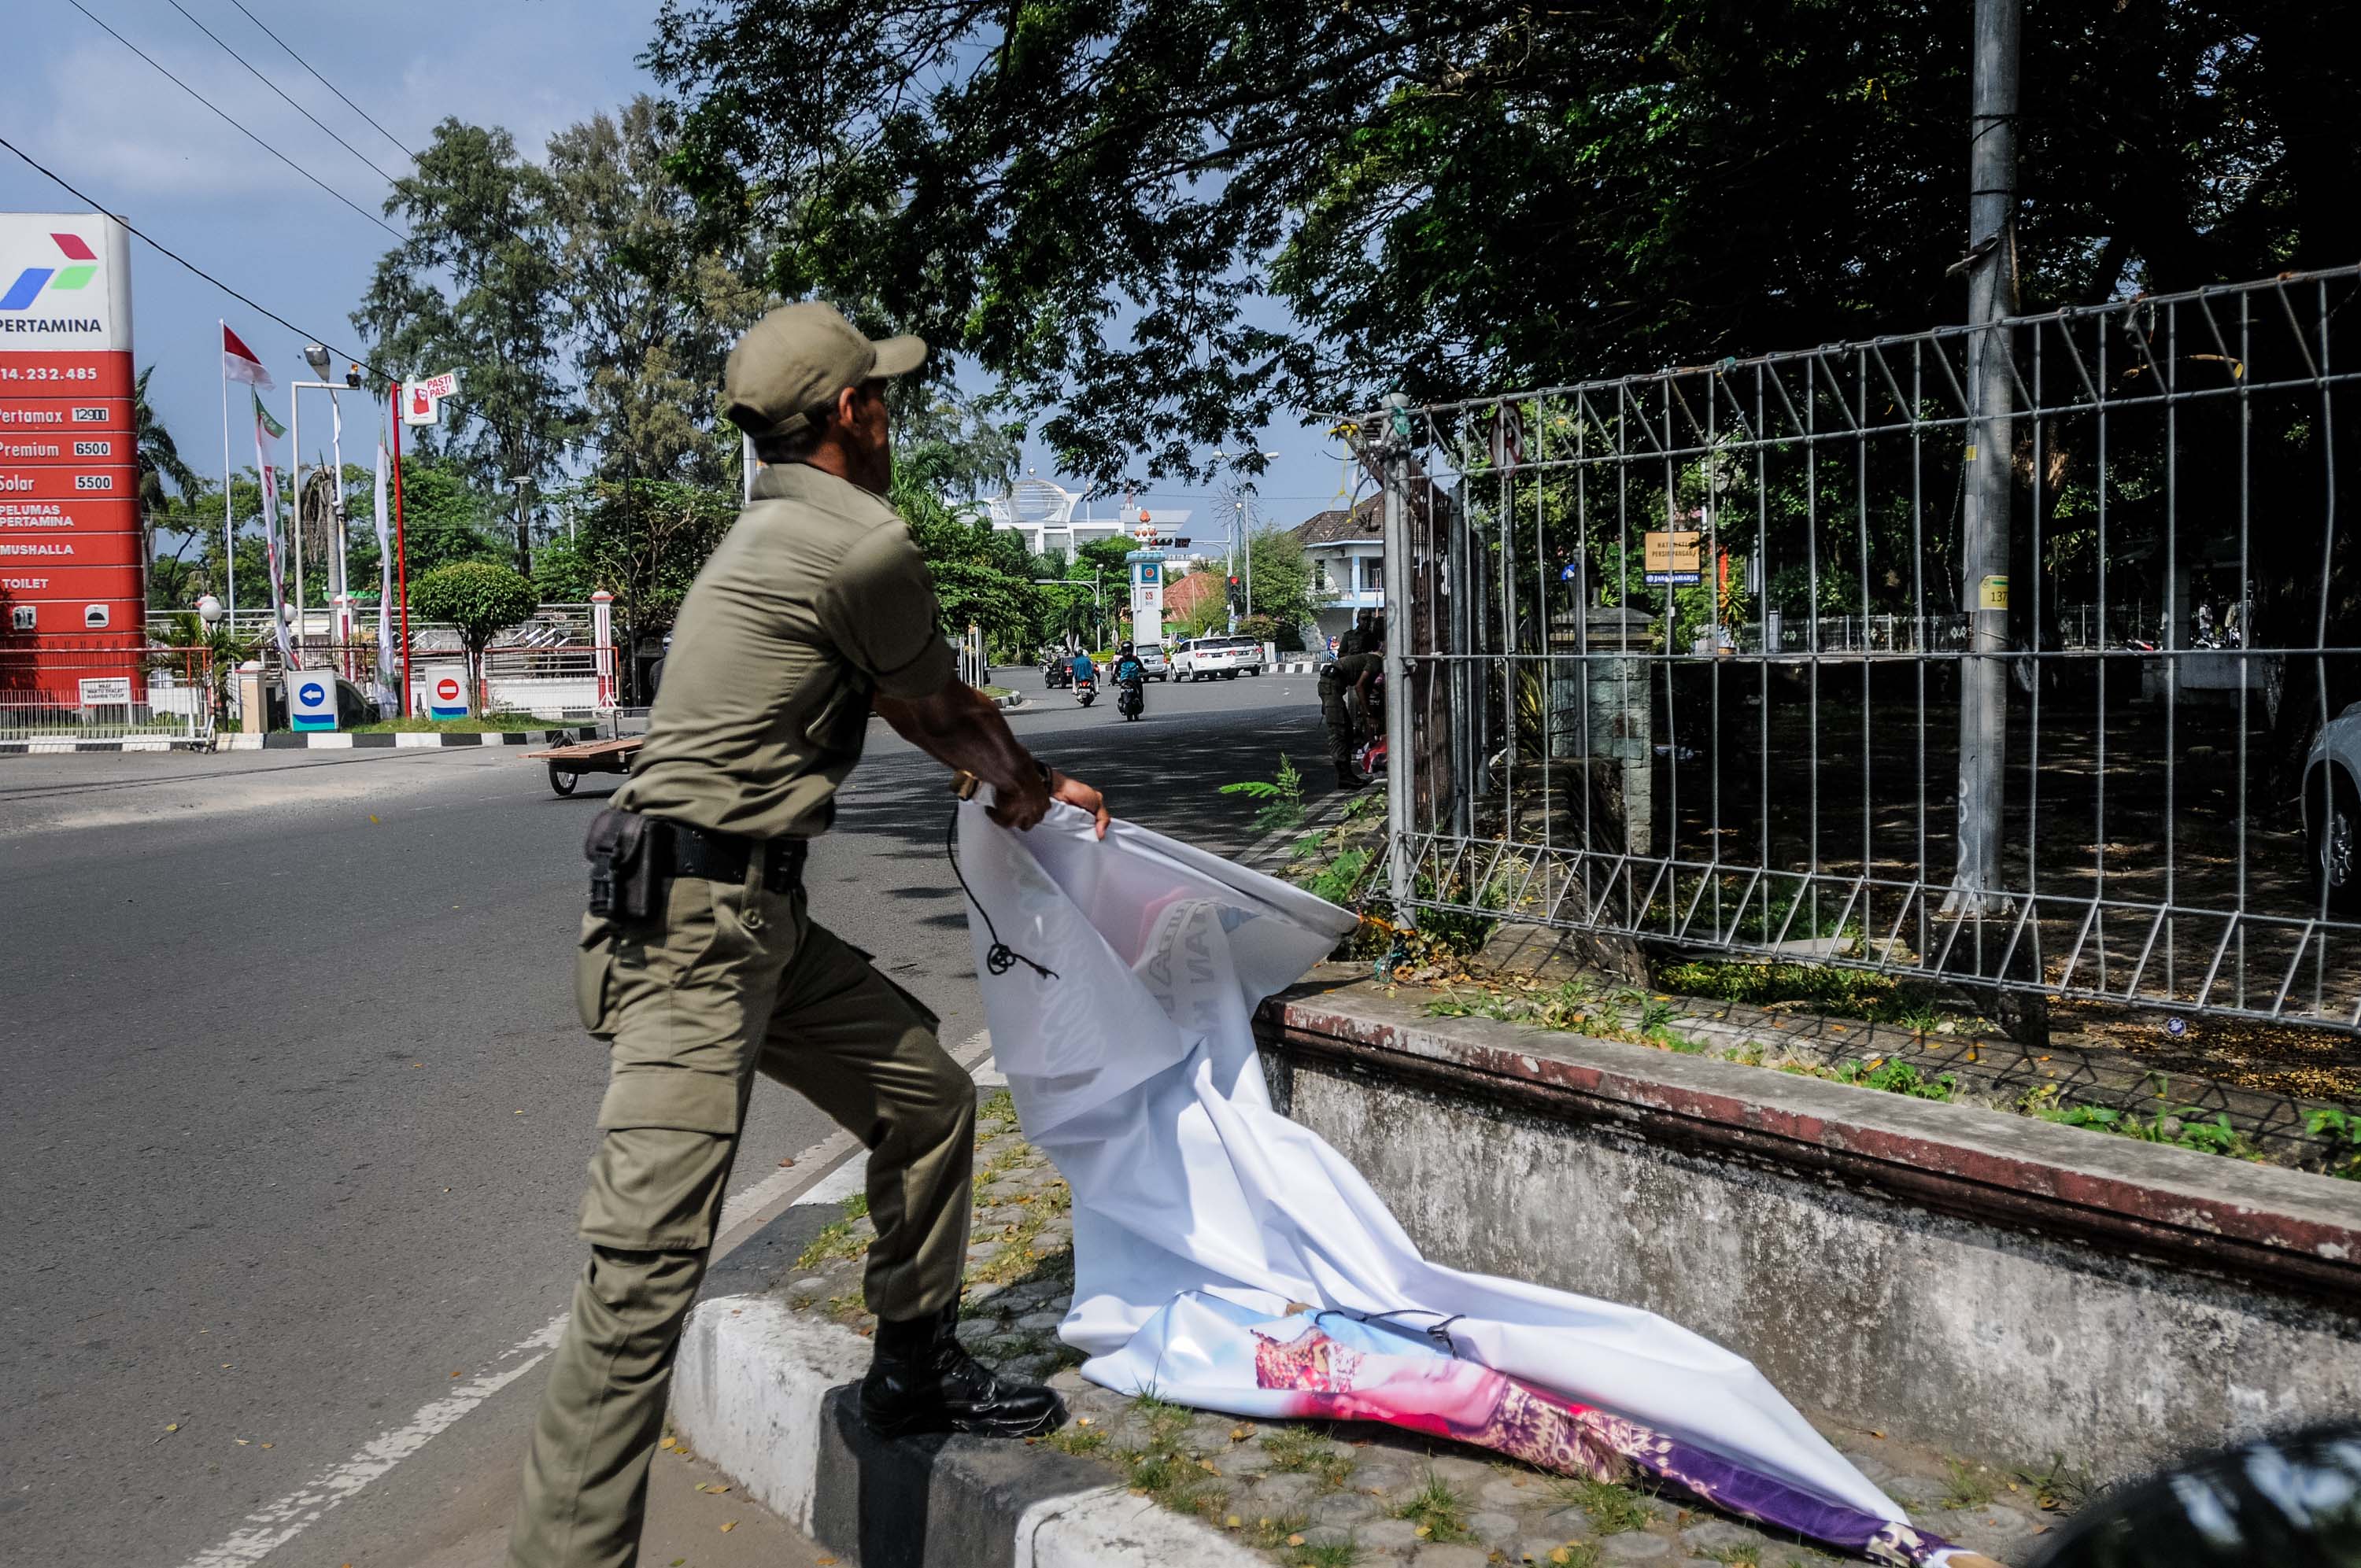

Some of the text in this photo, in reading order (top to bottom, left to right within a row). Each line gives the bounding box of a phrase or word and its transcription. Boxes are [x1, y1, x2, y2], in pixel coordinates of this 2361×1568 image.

[1, 367, 97, 380] 14.232.485
[427, 375, 452, 389] PASTI
[430, 386, 449, 398] PAS!
[0, 410, 63, 423] ertamax
[76, 443, 108, 454] 6500
[0, 474, 109, 491] Solar 5500
[0, 505, 61, 515] PELUMAS
[0, 516, 74, 527] PERTAMINA
[0, 544, 75, 555] MUSHALLA
[2, 578, 49, 588] TOILET
